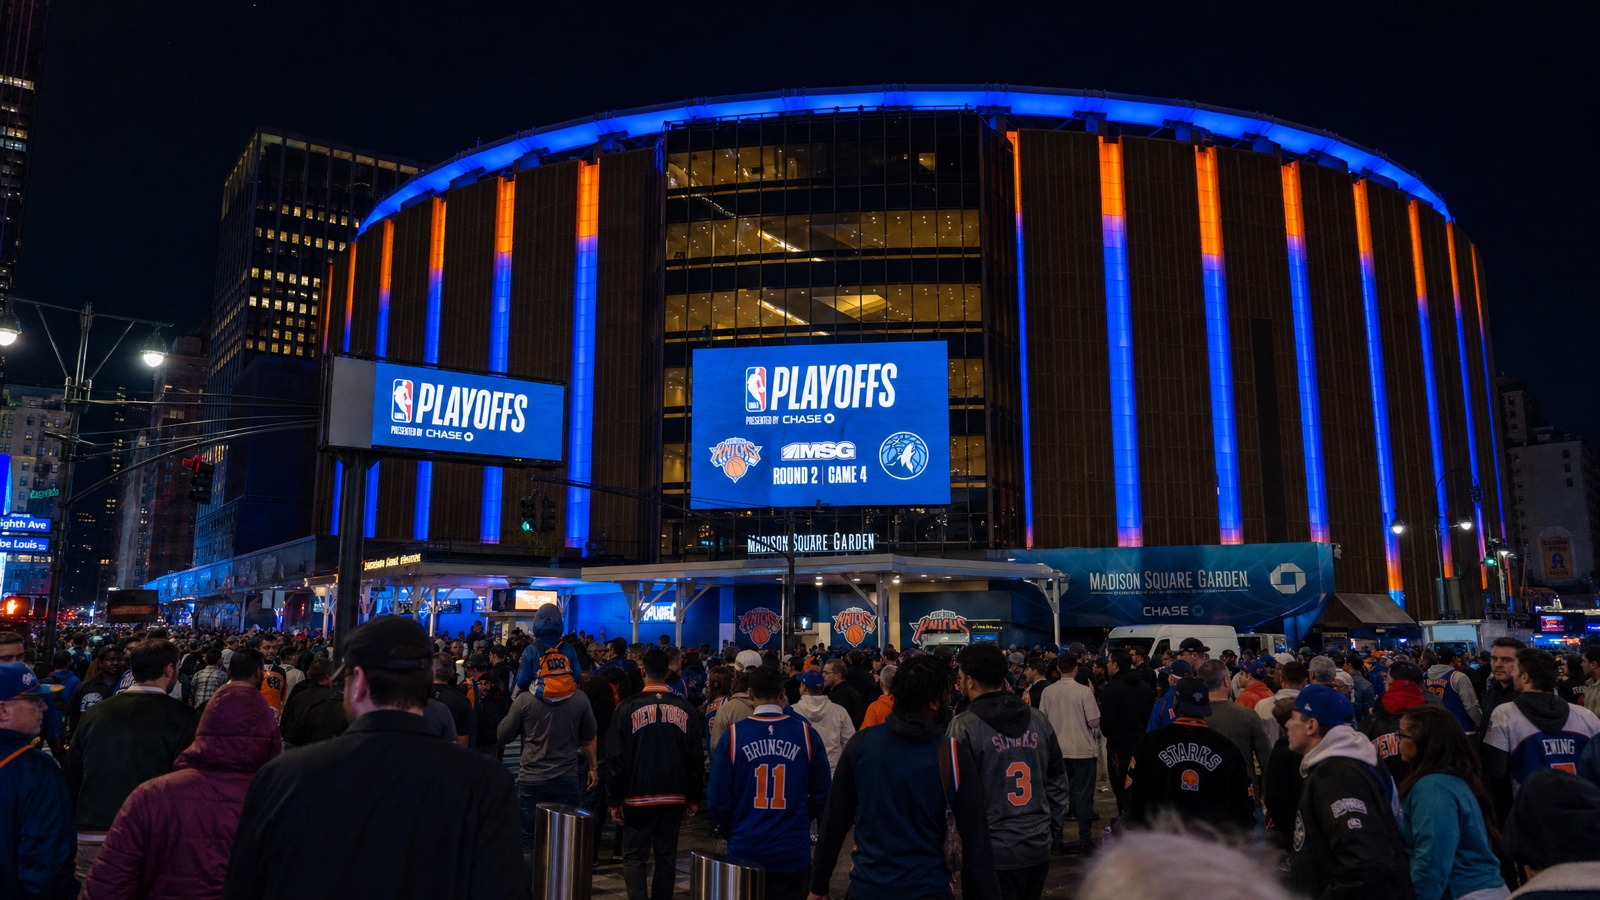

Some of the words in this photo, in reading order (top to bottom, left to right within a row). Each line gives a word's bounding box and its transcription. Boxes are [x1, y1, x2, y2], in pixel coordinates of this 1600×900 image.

[770, 363, 898, 411] PLAYOFFS
[416, 382, 528, 433] PLAYOFFS
[783, 415, 822, 424] CHASE
[426, 429, 463, 440] CHASE
[712, 443, 760, 461] KNICKS
[801, 442, 856, 460] MSG
[773, 467, 808, 485] ROUND
[811, 466, 819, 484] 2
[828, 466, 857, 484] GAME
[860, 466, 868, 483] 4
[28, 520, 47, 530] Ave
[14, 540, 37, 549] Louis
[748, 534, 789, 553] MADISON
[794, 533, 829, 552] SQUARE
[833, 532, 875, 551] GARDEN
[1089, 572, 1141, 591] MADISON
[1144, 571, 1194, 591] SQUARE
[740, 611, 780, 629] KNICKS
[835, 611, 875, 629] KNICKS
[1142, 605, 1190, 617] CHASE
[914, 617, 970, 641] KNICKS
[630, 703, 658, 734] NEW
[659, 703, 689, 734] YORK
[742, 738, 801, 762] BRUNSON
[1542, 738, 1576, 756] EWING
[1158, 742, 1223, 772] STARKS
[754, 763, 787, 810] 11
[1006, 761, 1032, 807] 3
